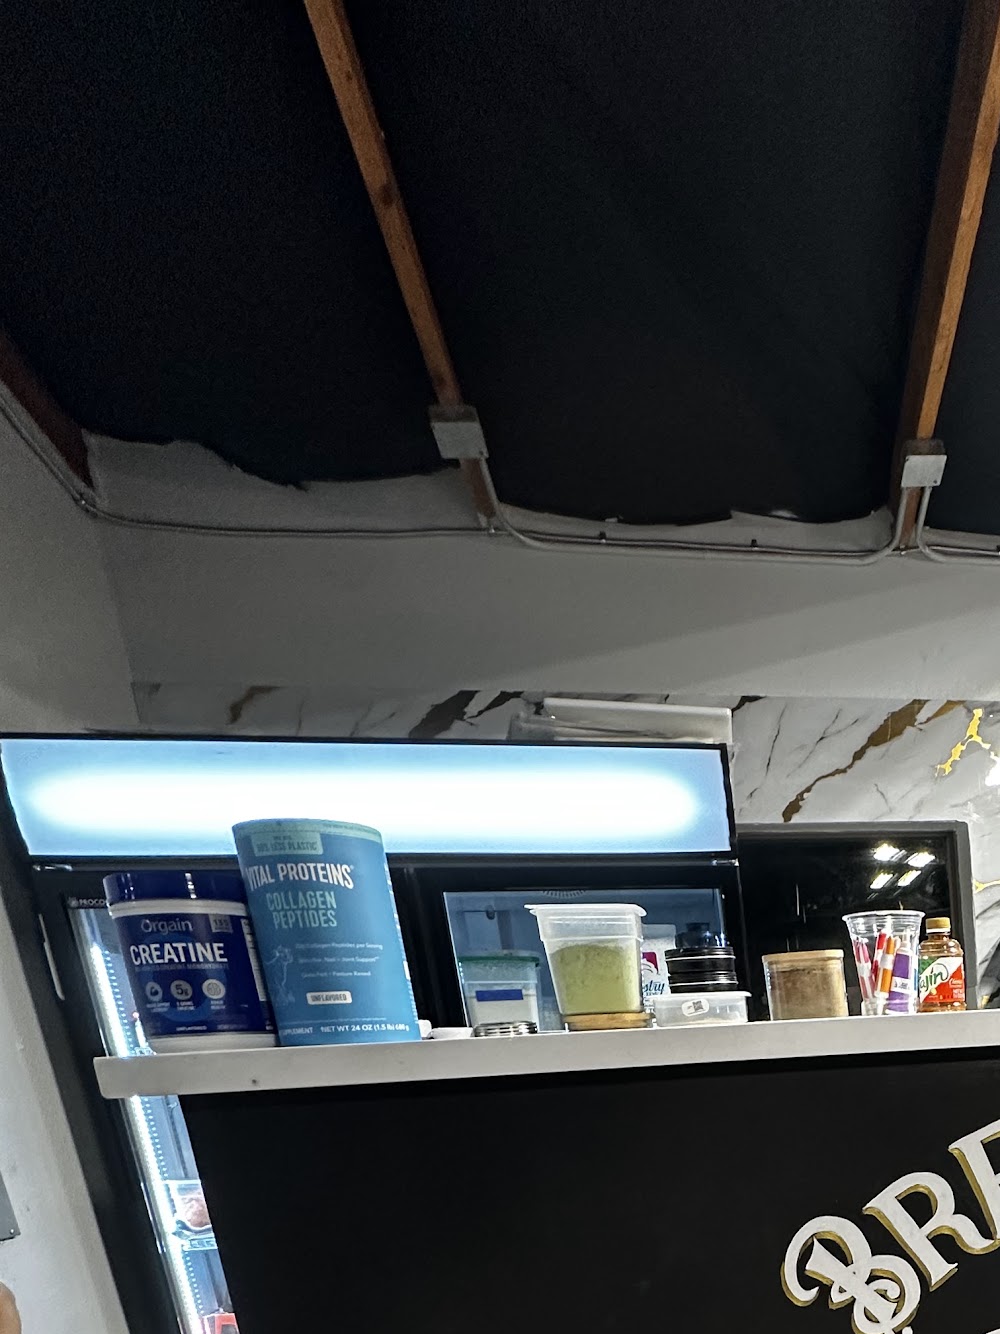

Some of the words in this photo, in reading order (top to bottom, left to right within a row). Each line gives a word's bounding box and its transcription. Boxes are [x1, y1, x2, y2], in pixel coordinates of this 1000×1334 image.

[245, 864, 275, 891] VITAL
[276, 863, 354, 890] PROTEINS
[265, 891, 337, 910] COLLAGEN
[140, 918, 193, 935] Orgain
[272, 910, 338, 929] PEPTIDES
[129, 942, 228, 966] CREATINE
